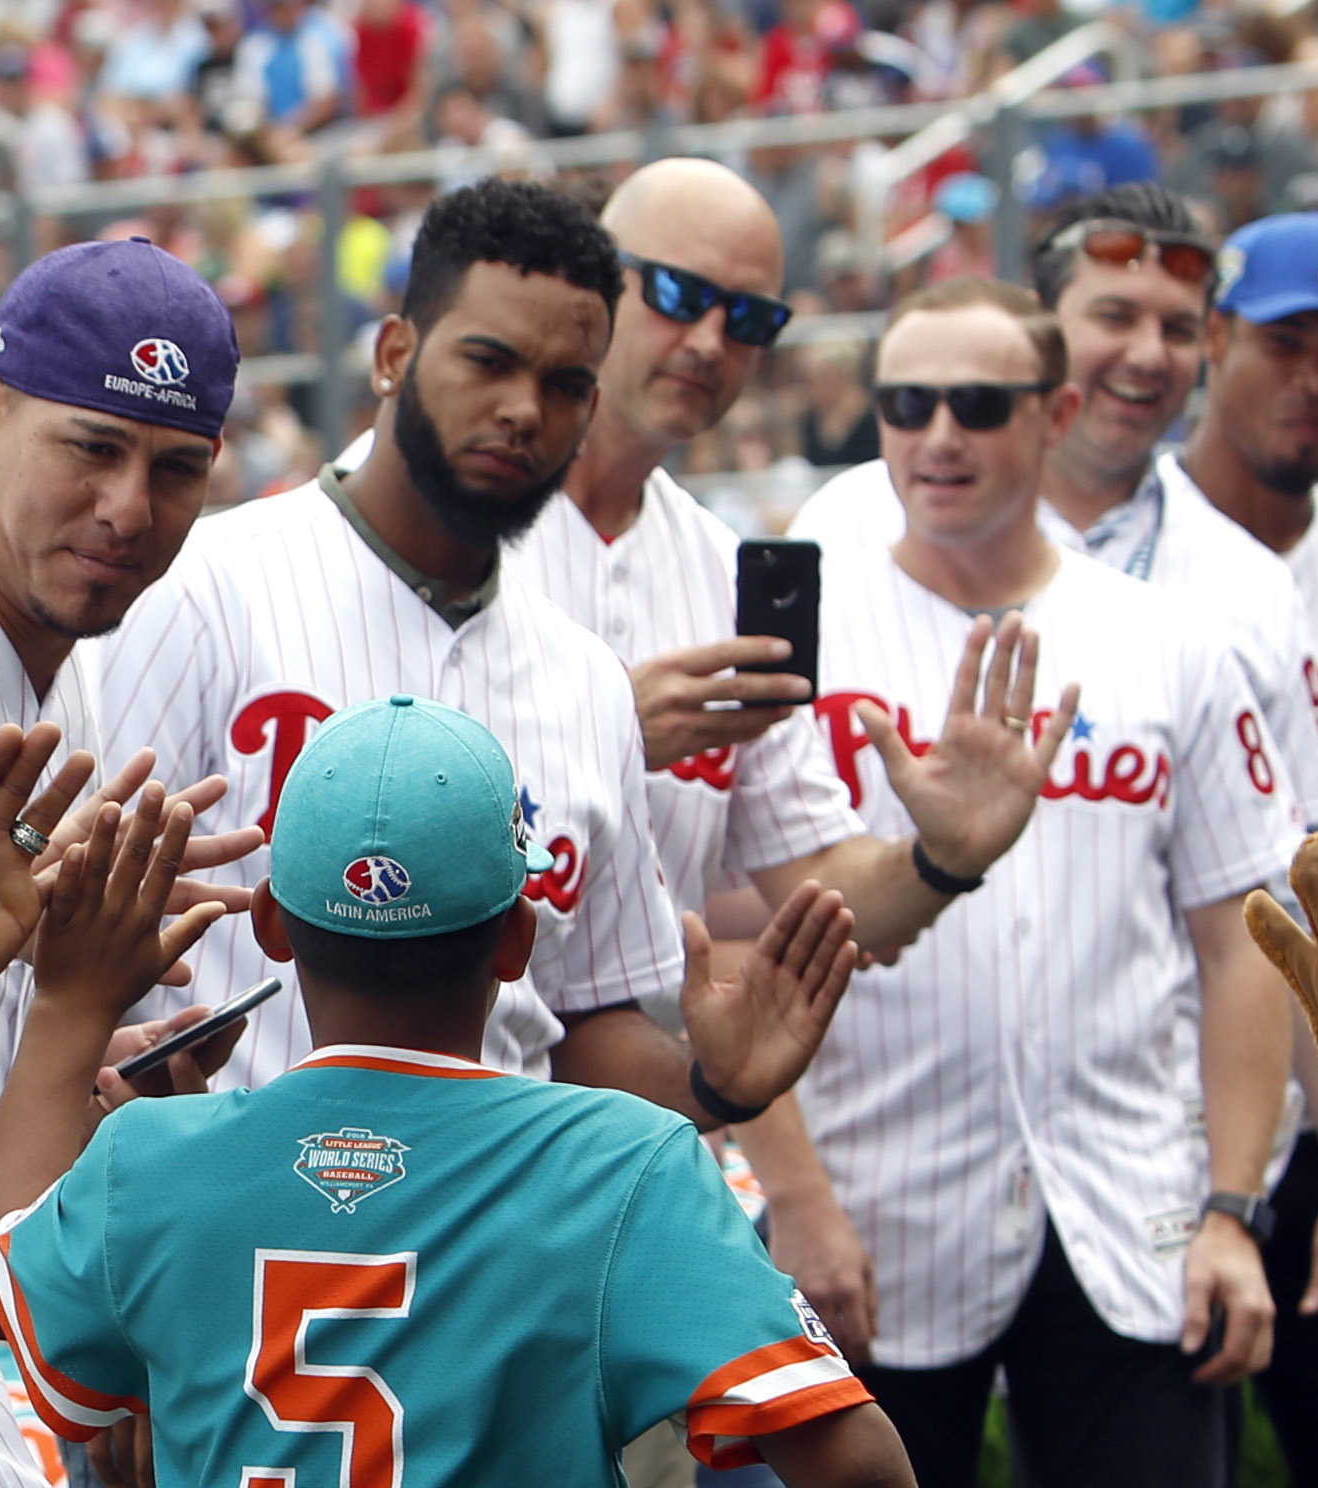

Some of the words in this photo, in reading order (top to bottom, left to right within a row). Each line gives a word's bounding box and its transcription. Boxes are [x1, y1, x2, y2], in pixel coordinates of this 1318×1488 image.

[104, 373, 198, 411] EUROPE-AFRICA
[1236, 710, 1274, 795] 8
[325, 899, 362, 919] LATIN
[365, 903, 433, 923] AMERICA
[324, 1140, 353, 1149] LITTLE
[354, 1141, 384, 1151] LEAGUE
[308, 1149, 351, 1168] WORLD
[351, 1151, 396, 1174] SERIES
[322, 1170, 374, 1182] BASEBALL
